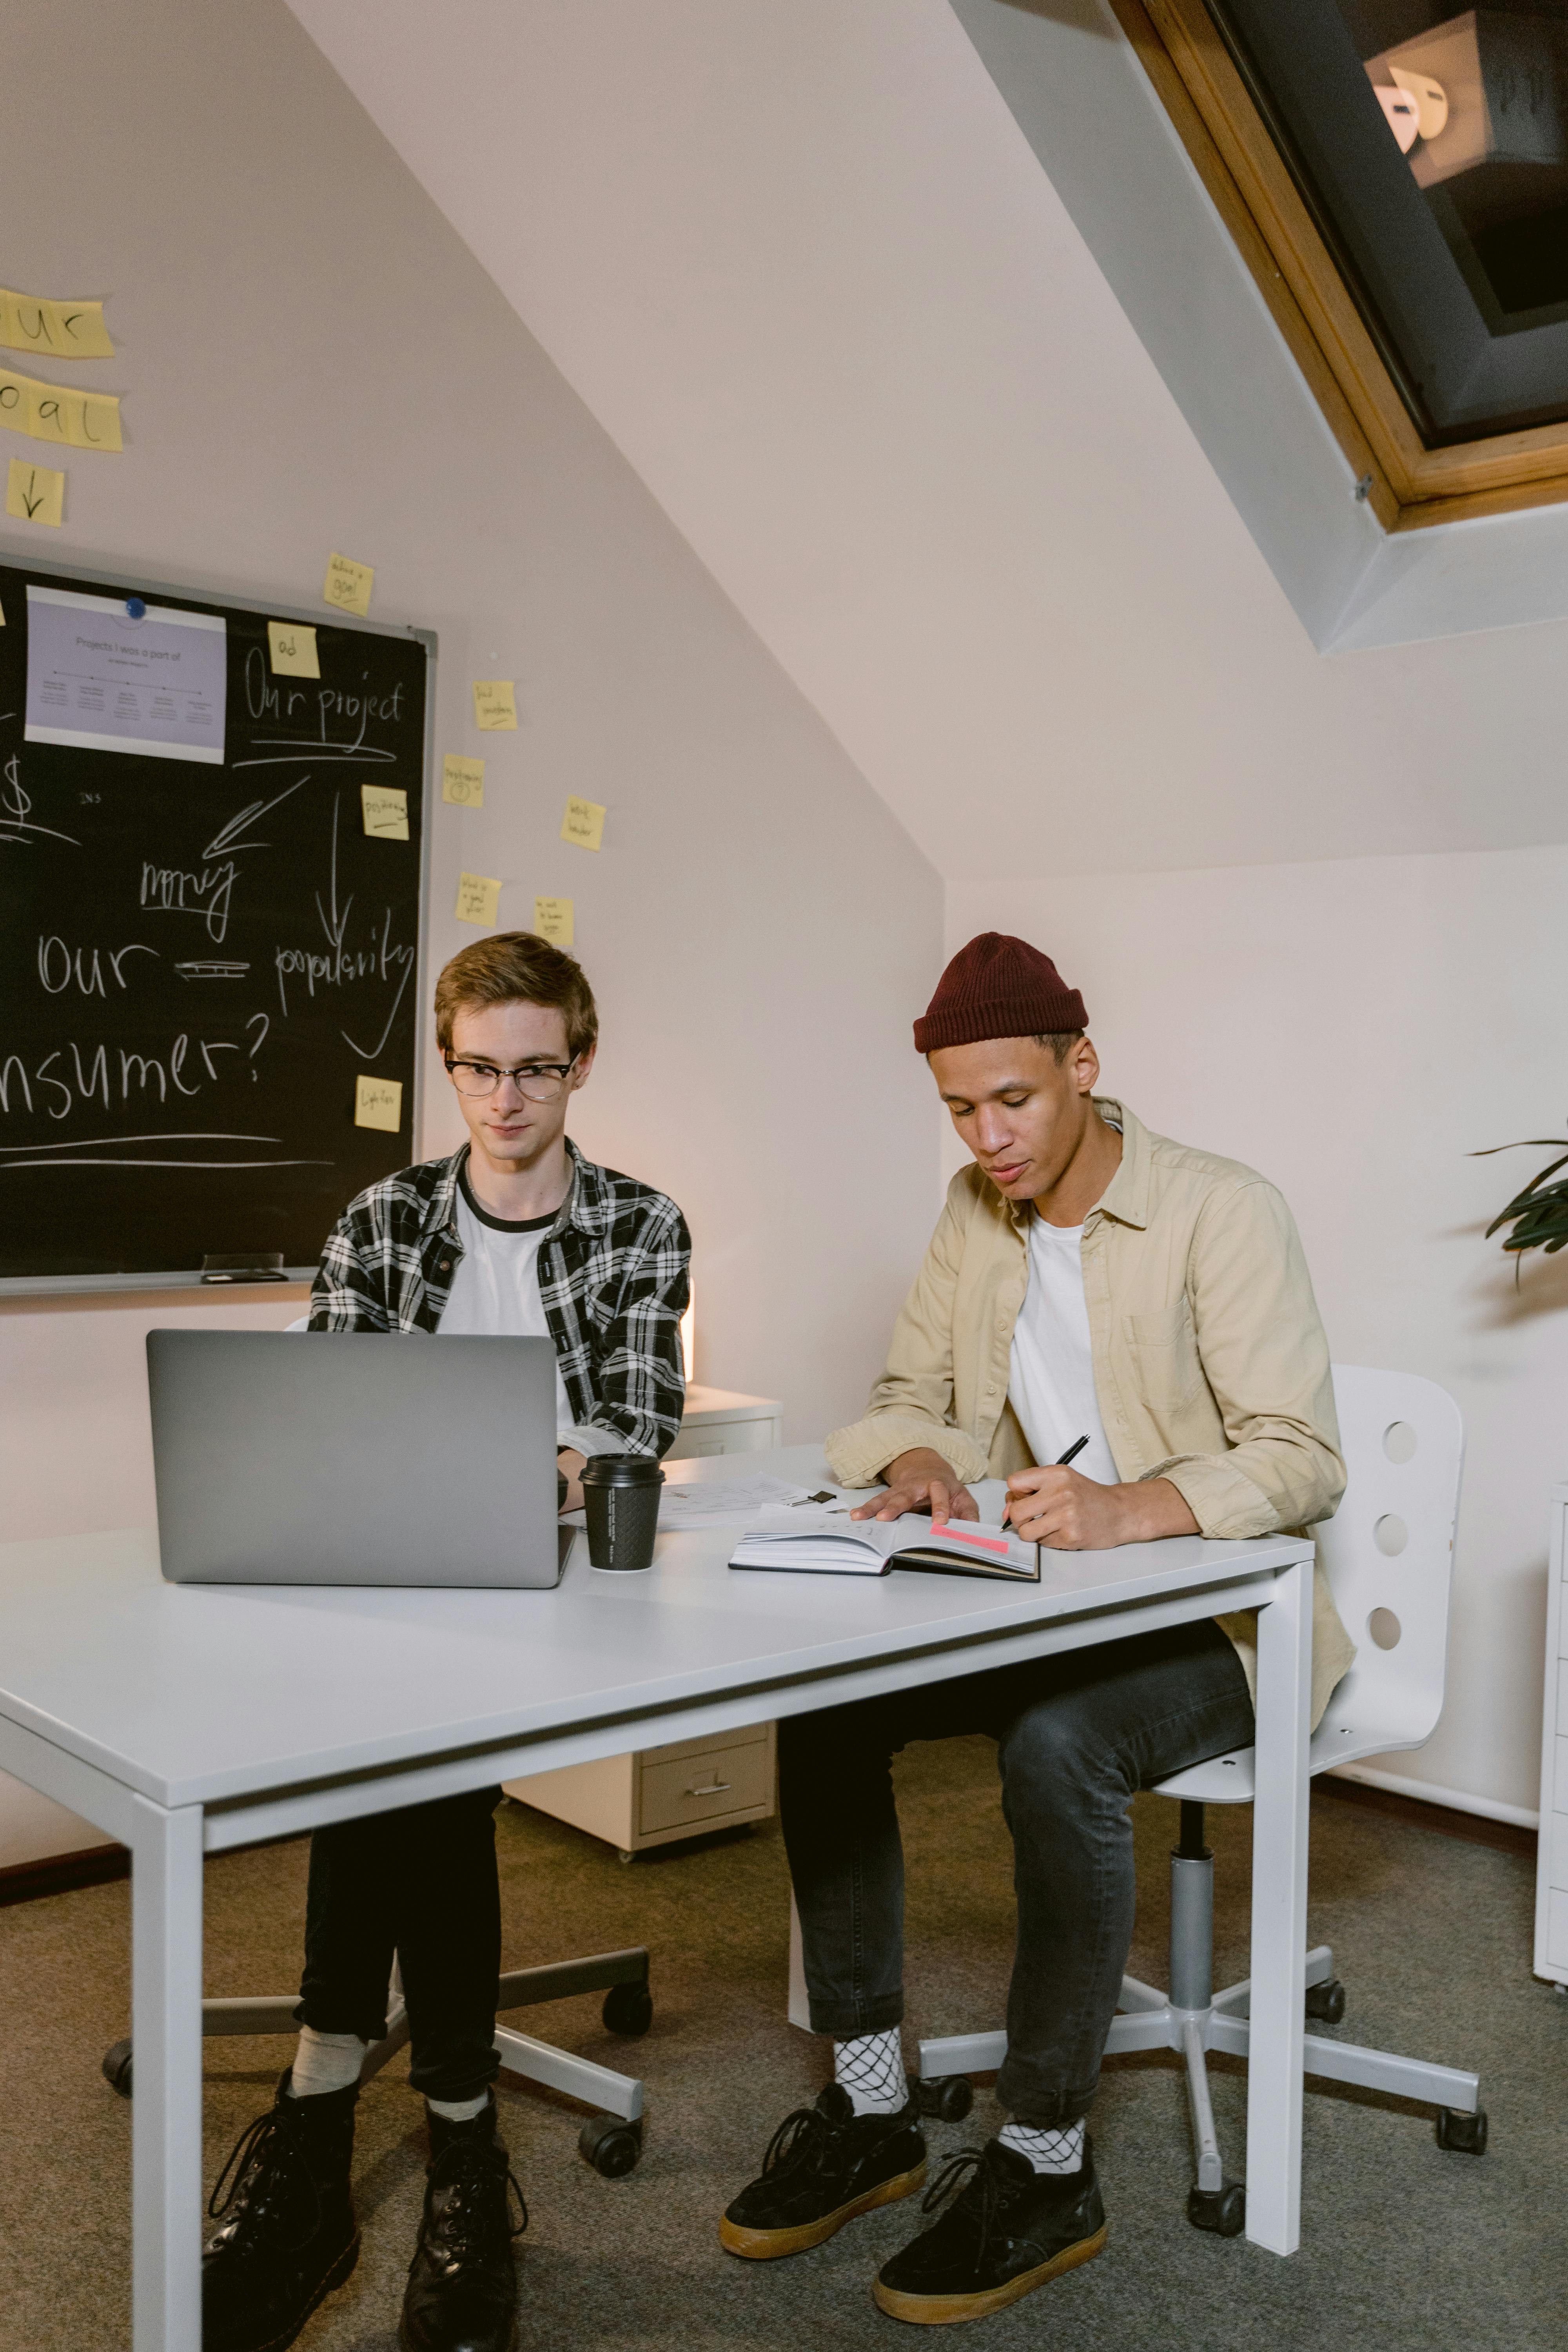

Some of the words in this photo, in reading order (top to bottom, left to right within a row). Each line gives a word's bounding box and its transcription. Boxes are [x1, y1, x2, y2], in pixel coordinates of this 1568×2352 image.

[76, 636, 112, 651] Projects
[120, 646, 138, 656] was
[150, 651, 169, 660] part
[171, 652, 181, 661] of
[245, 646, 307, 719] Our
[318, 671, 405, 753] project
[39, 936, 160, 998] Our
[276, 907, 414, 1059] popularity
